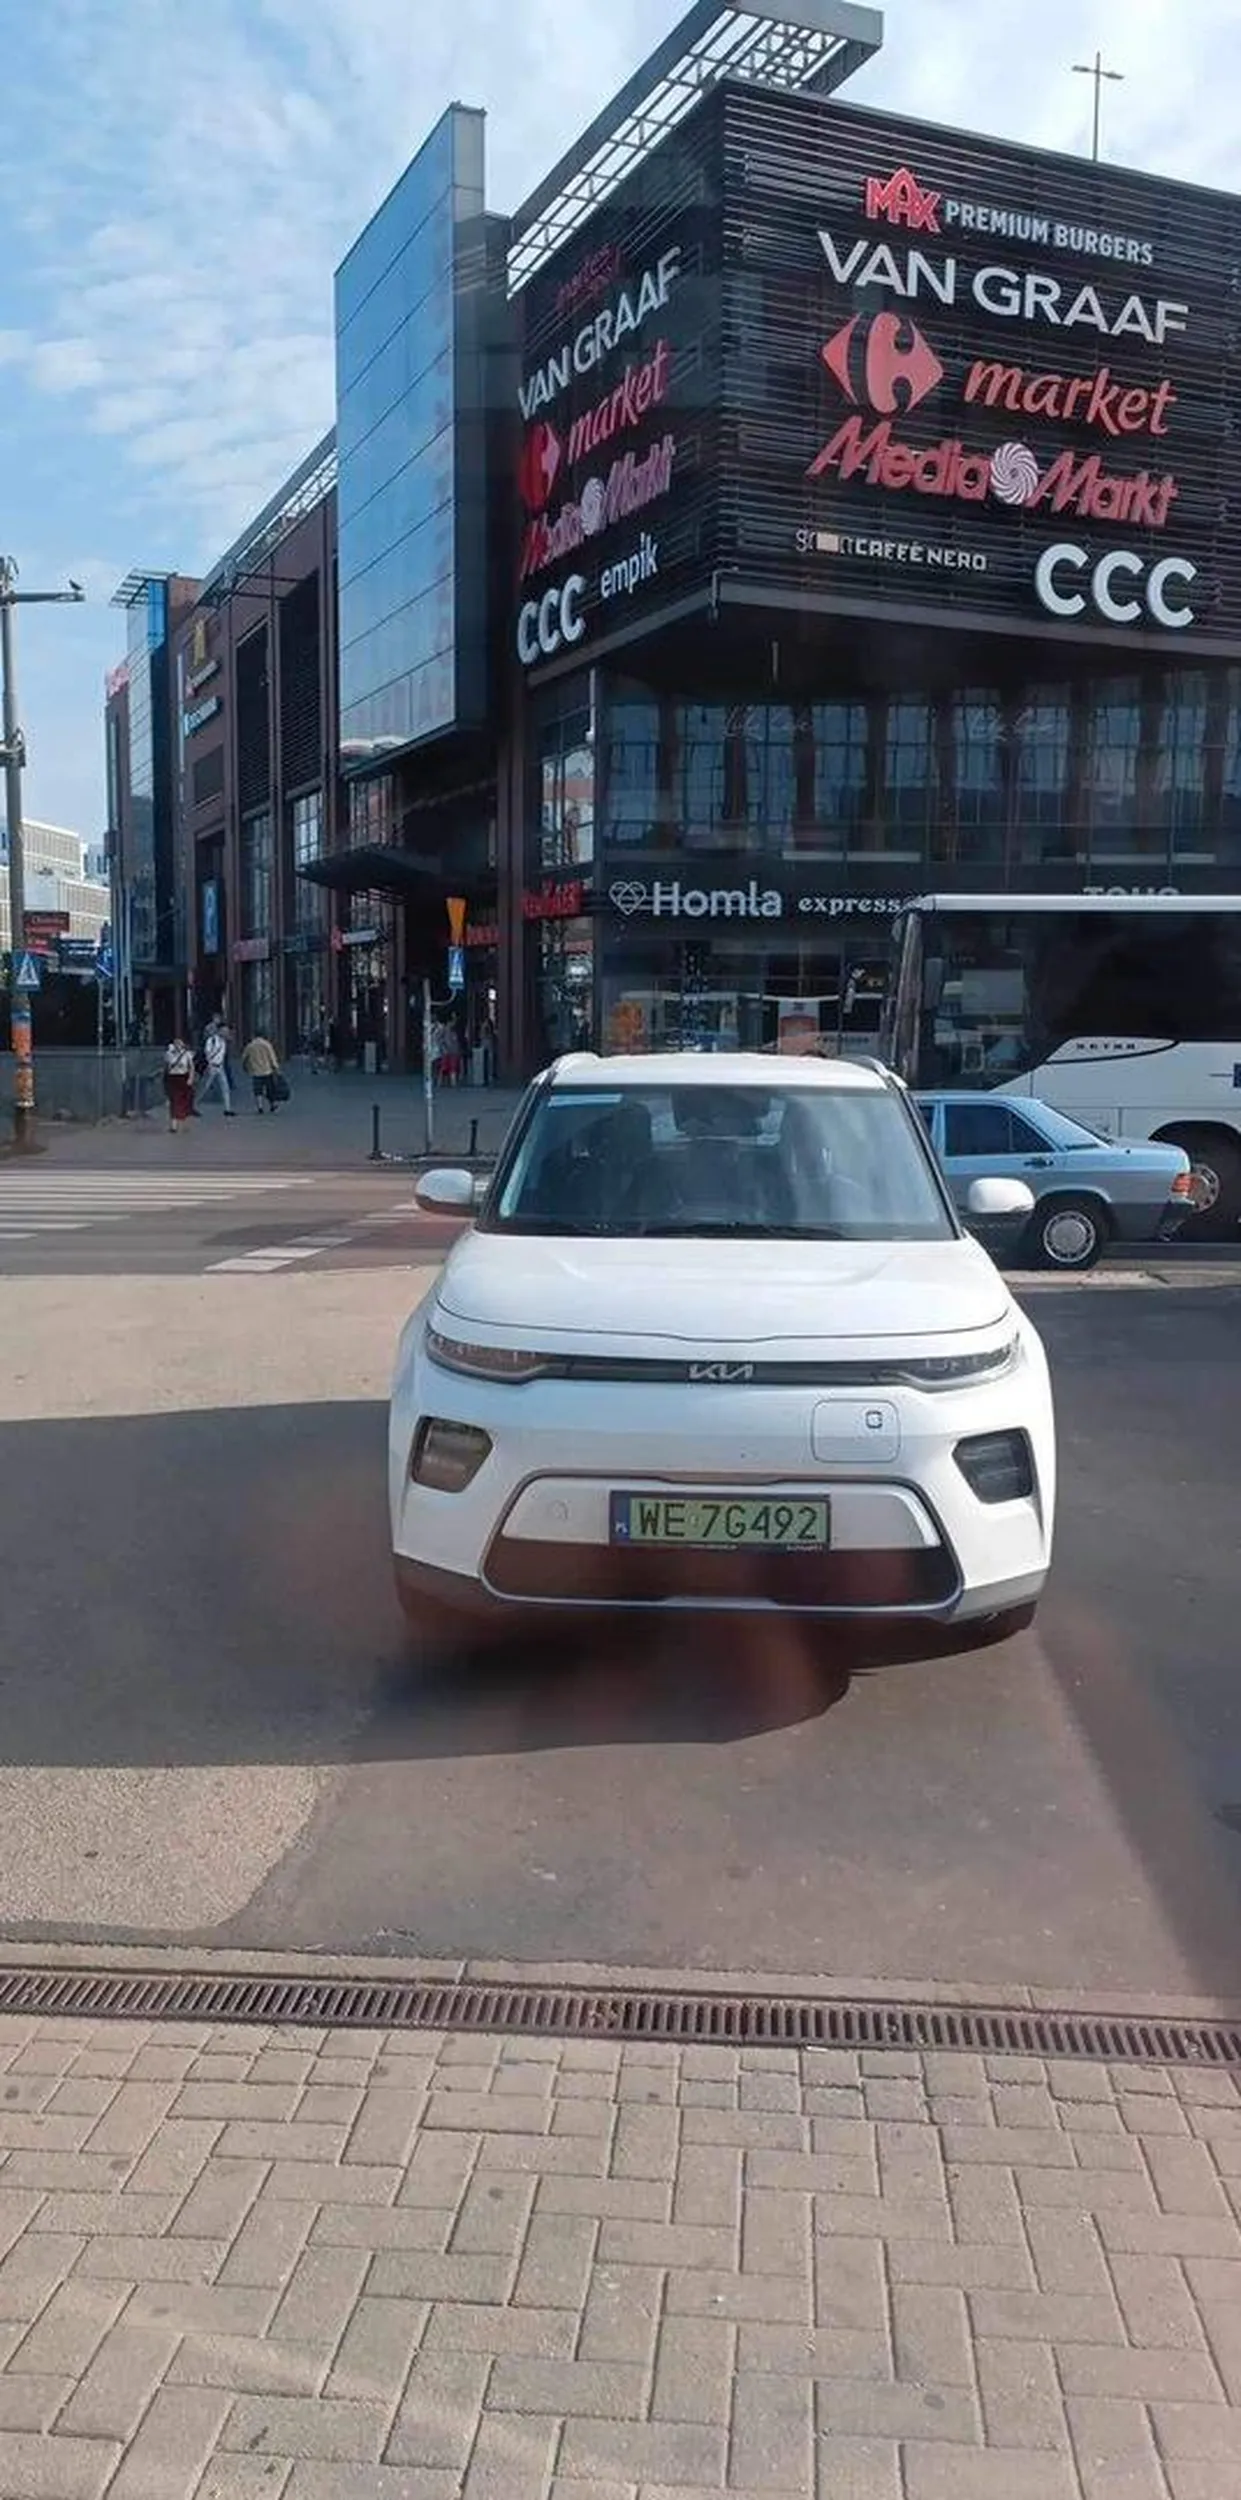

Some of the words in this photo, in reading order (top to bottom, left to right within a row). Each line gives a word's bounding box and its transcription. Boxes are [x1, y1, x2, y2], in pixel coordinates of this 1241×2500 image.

[864, 166, 941, 234] MAX
[944, 199, 1050, 243] PREMIUM
[1054, 224, 1153, 265] BURGERS
[517, 345, 571, 421] VAN
[573, 246, 681, 374] GRAAF
[817, 230, 956, 305] VAN
[972, 266, 1189, 344] GRAAF
[567, 338, 669, 466] market
[963, 360, 1178, 436] market
[804, 415, 994, 501] Media
[1022, 450, 1179, 527] Markt
[517, 573, 586, 664] CCC
[600, 532, 659, 598] empik
[927, 546, 988, 571] NERO
[1034, 542, 1198, 629] CCC
[652, 880, 783, 918] Homla
[798, 894, 903, 915] express
[639, 1502, 685, 1538] WE
[700, 1504, 817, 1540] 7G492
